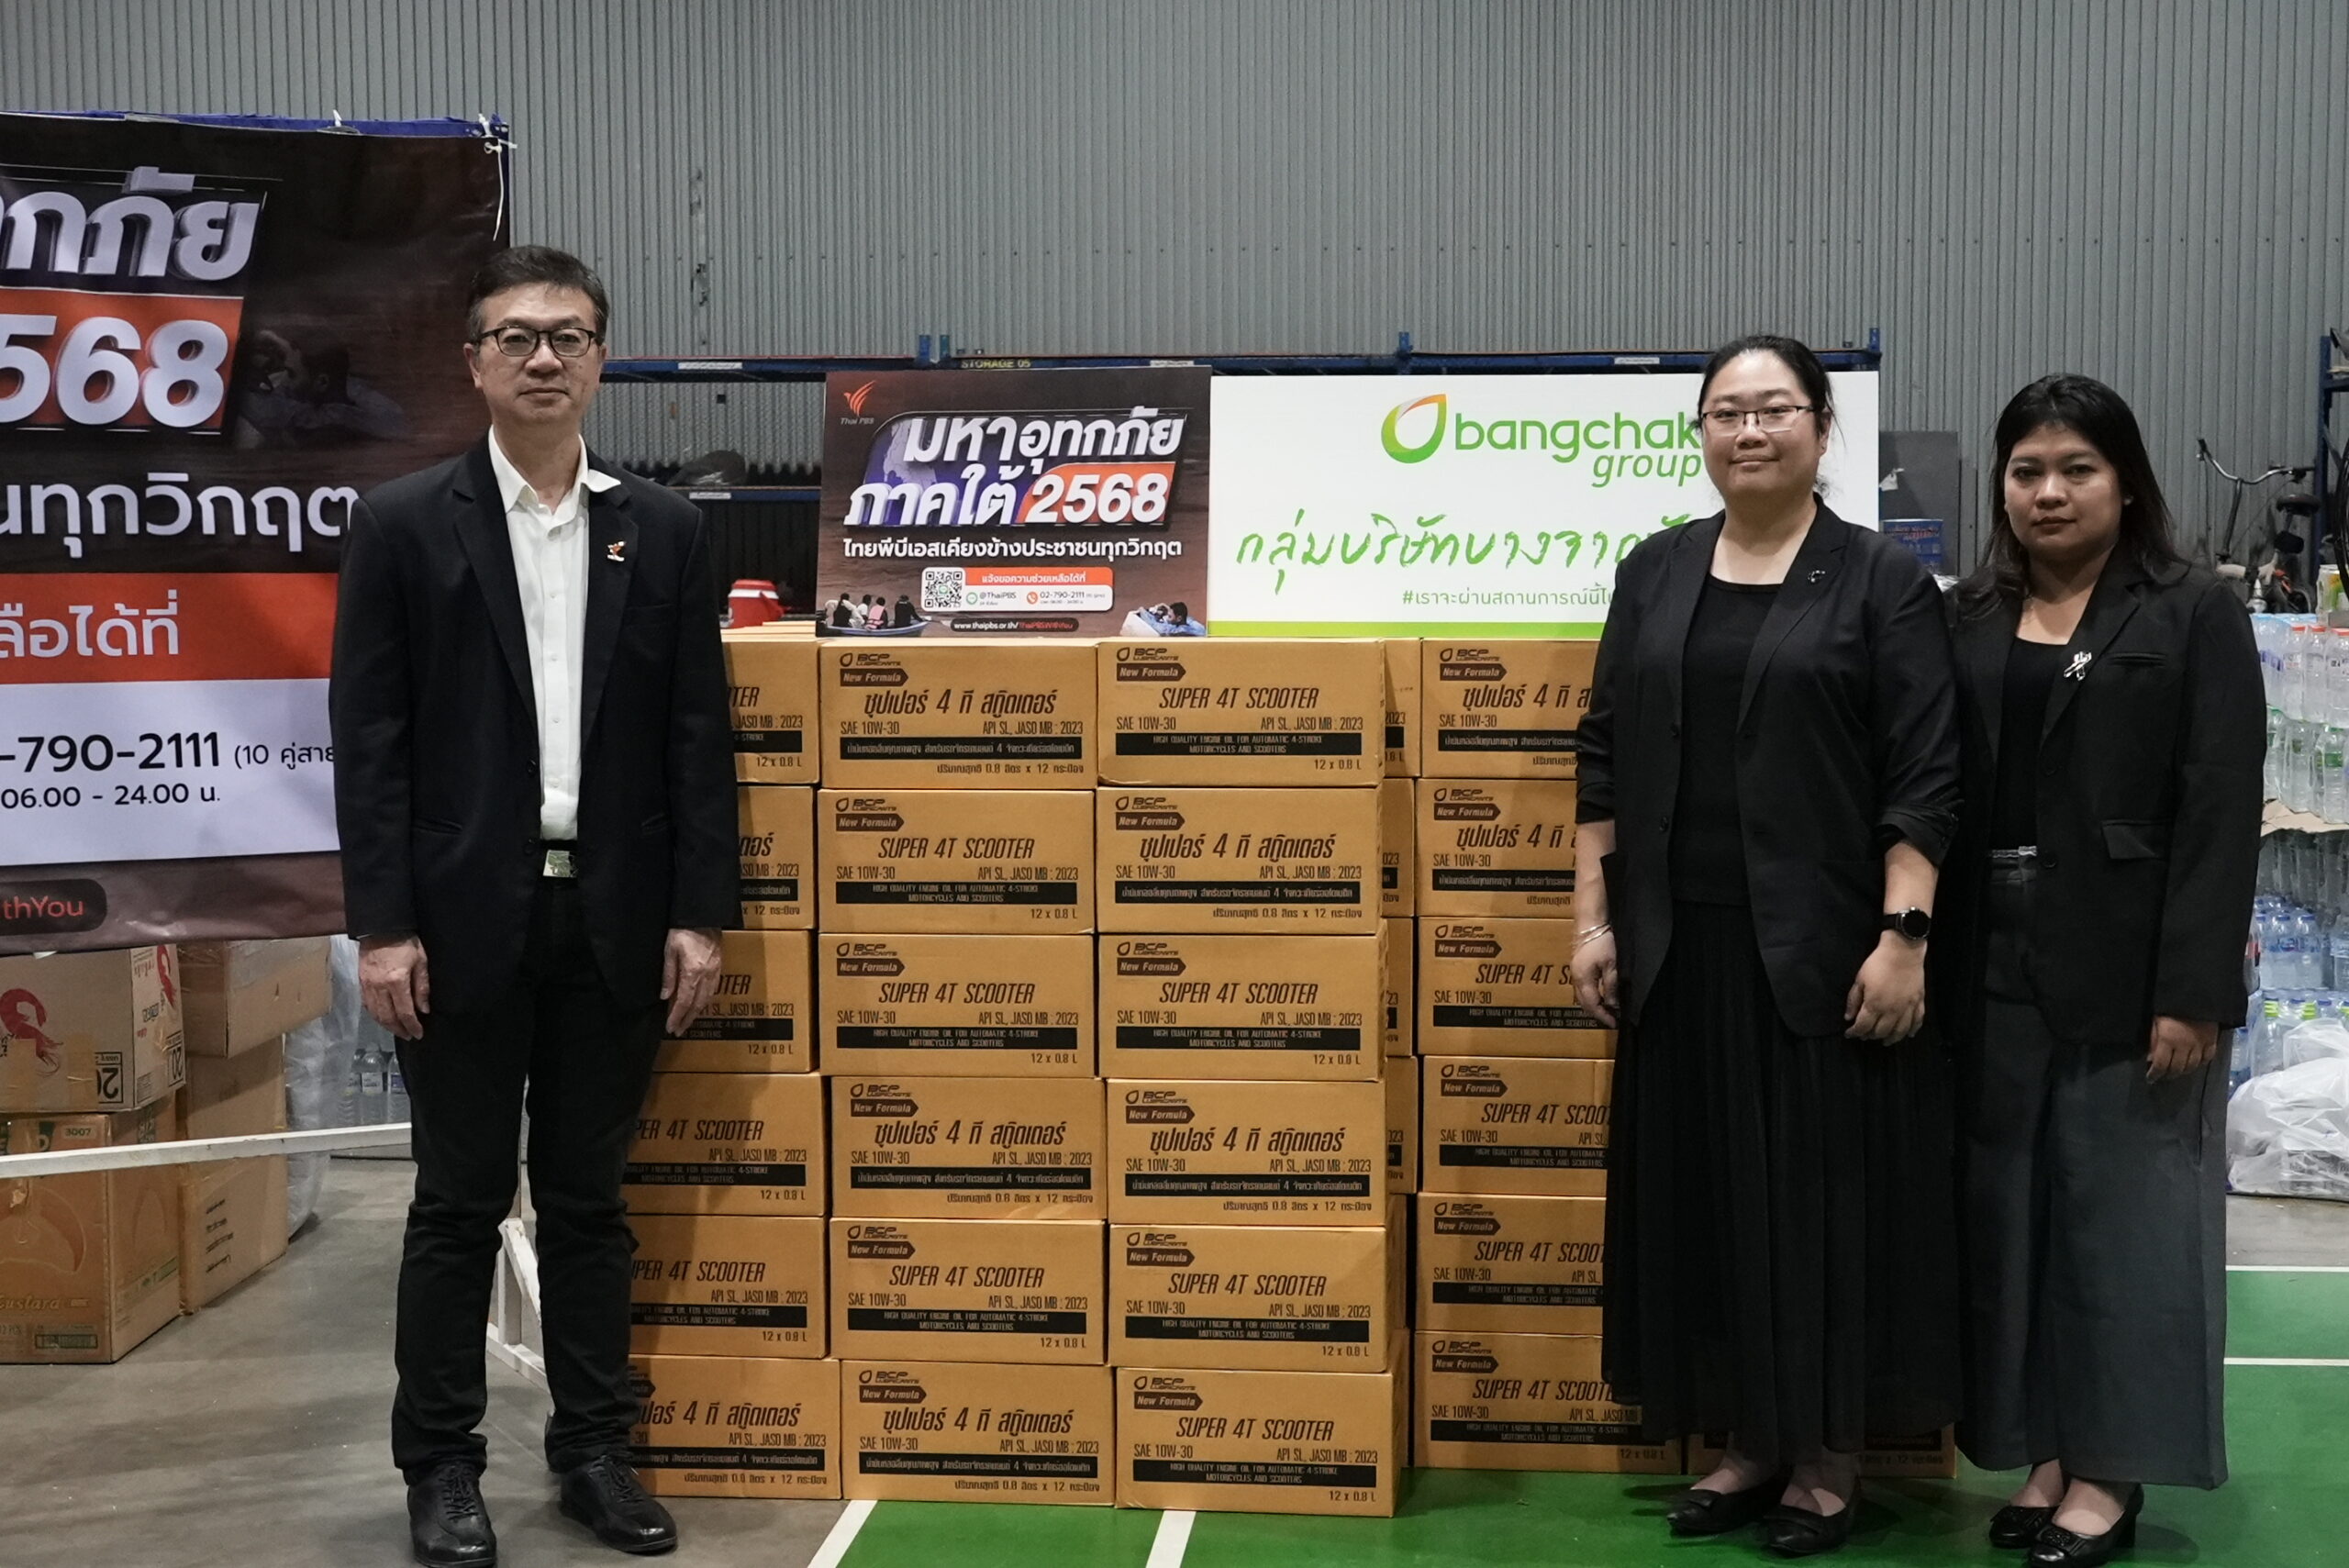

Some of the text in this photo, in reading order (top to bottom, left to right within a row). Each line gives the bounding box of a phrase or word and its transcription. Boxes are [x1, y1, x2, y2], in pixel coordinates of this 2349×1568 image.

[0, 165, 262, 282] กภัย
[860, 417, 874, 425] PBS
[1454, 412, 1700, 463] bangchak
[1592, 454, 1702, 488] group
[843, 463, 1171, 527] ภาคใต้ 2568
[843, 537, 1182, 562] ไทยพีบีเอสเคียงข้างประชาชนทุกวิกฤต
[1403, 582, 1612, 606] #เราจะผ่านสถานการณ์นี้ไ
[843, 673, 901, 682] New Formula
[1119, 667, 1179, 677] New Formula
[936, 689, 952, 714] 4
[959, 690, 974, 714] ที
[1159, 687, 1319, 708] SUPER 4T SCOOTER
[1533, 684, 1547, 707] 4
[1556, 685, 1571, 707] ที
[780, 716, 803, 728] 2023
[841, 721, 900, 735] SAE 10W-30
[983, 721, 997, 734] API
[1015, 721, 1037, 734] JASO
[1040, 721, 1052, 734] MB
[1060, 721, 1084, 734] 2023
[1117, 717, 1176, 730] SAE 10W-30
[1261, 717, 1275, 730] API
[1294, 717, 1316, 730] JASO
[1319, 717, 1332, 730] MB
[1340, 717, 1364, 730] 2023
[1440, 715, 1497, 728] SAE 10W-30
[234, 744, 270, 769] (10
[1315, 760, 1326, 770] 12
[1037, 763, 1048, 773] 12
[1, 786, 81, 808] 06.00
[114, 784, 189, 806] 24.00
[1213, 833, 1229, 858] 4
[1236, 834, 1252, 858] ที
[1528, 824, 1542, 848] 4
[1550, 826, 1564, 848] ที
[877, 838, 1035, 859] SUPER 4T SCOOTER
[1475, 964, 1553, 984] SUPER 4T
[878, 983, 1036, 1004] SUPER 4T SCOOTER
[1159, 982, 1319, 1004] SUPER 4T SCOOTER
[96, 1067, 119, 1100] 2
[853, 1104, 911, 1114] New Formula
[1482, 1104, 1612, 1125] SUPER 4T SCOO
[667, 1120, 764, 1141] 4T SCOOTER
[946, 1121, 962, 1145] 4
[969, 1122, 984, 1145] ที
[1222, 1127, 1239, 1151] 4
[1246, 1128, 1262, 1151] ที
[1475, 1241, 1604, 1262] SUPER 4T SCOO
[669, 1261, 766, 1283] 4T SCOOTER
[889, 1265, 1045, 1288] SUPER 4T SCOOTER
[1168, 1273, 1327, 1296] SUPER 4T SCOOTER
[1473, 1379, 1521, 1399] SUPER
[1528, 1381, 1550, 1400] 4T
[683, 1401, 699, 1425] 4
[706, 1401, 721, 1425] ที
[954, 1407, 970, 1431] 4
[976, 1408, 992, 1432] ที
[1175, 1417, 1334, 1441] SUPER 4T SCOOTER
[1134, 1443, 1193, 1458] SAE 10W-30
